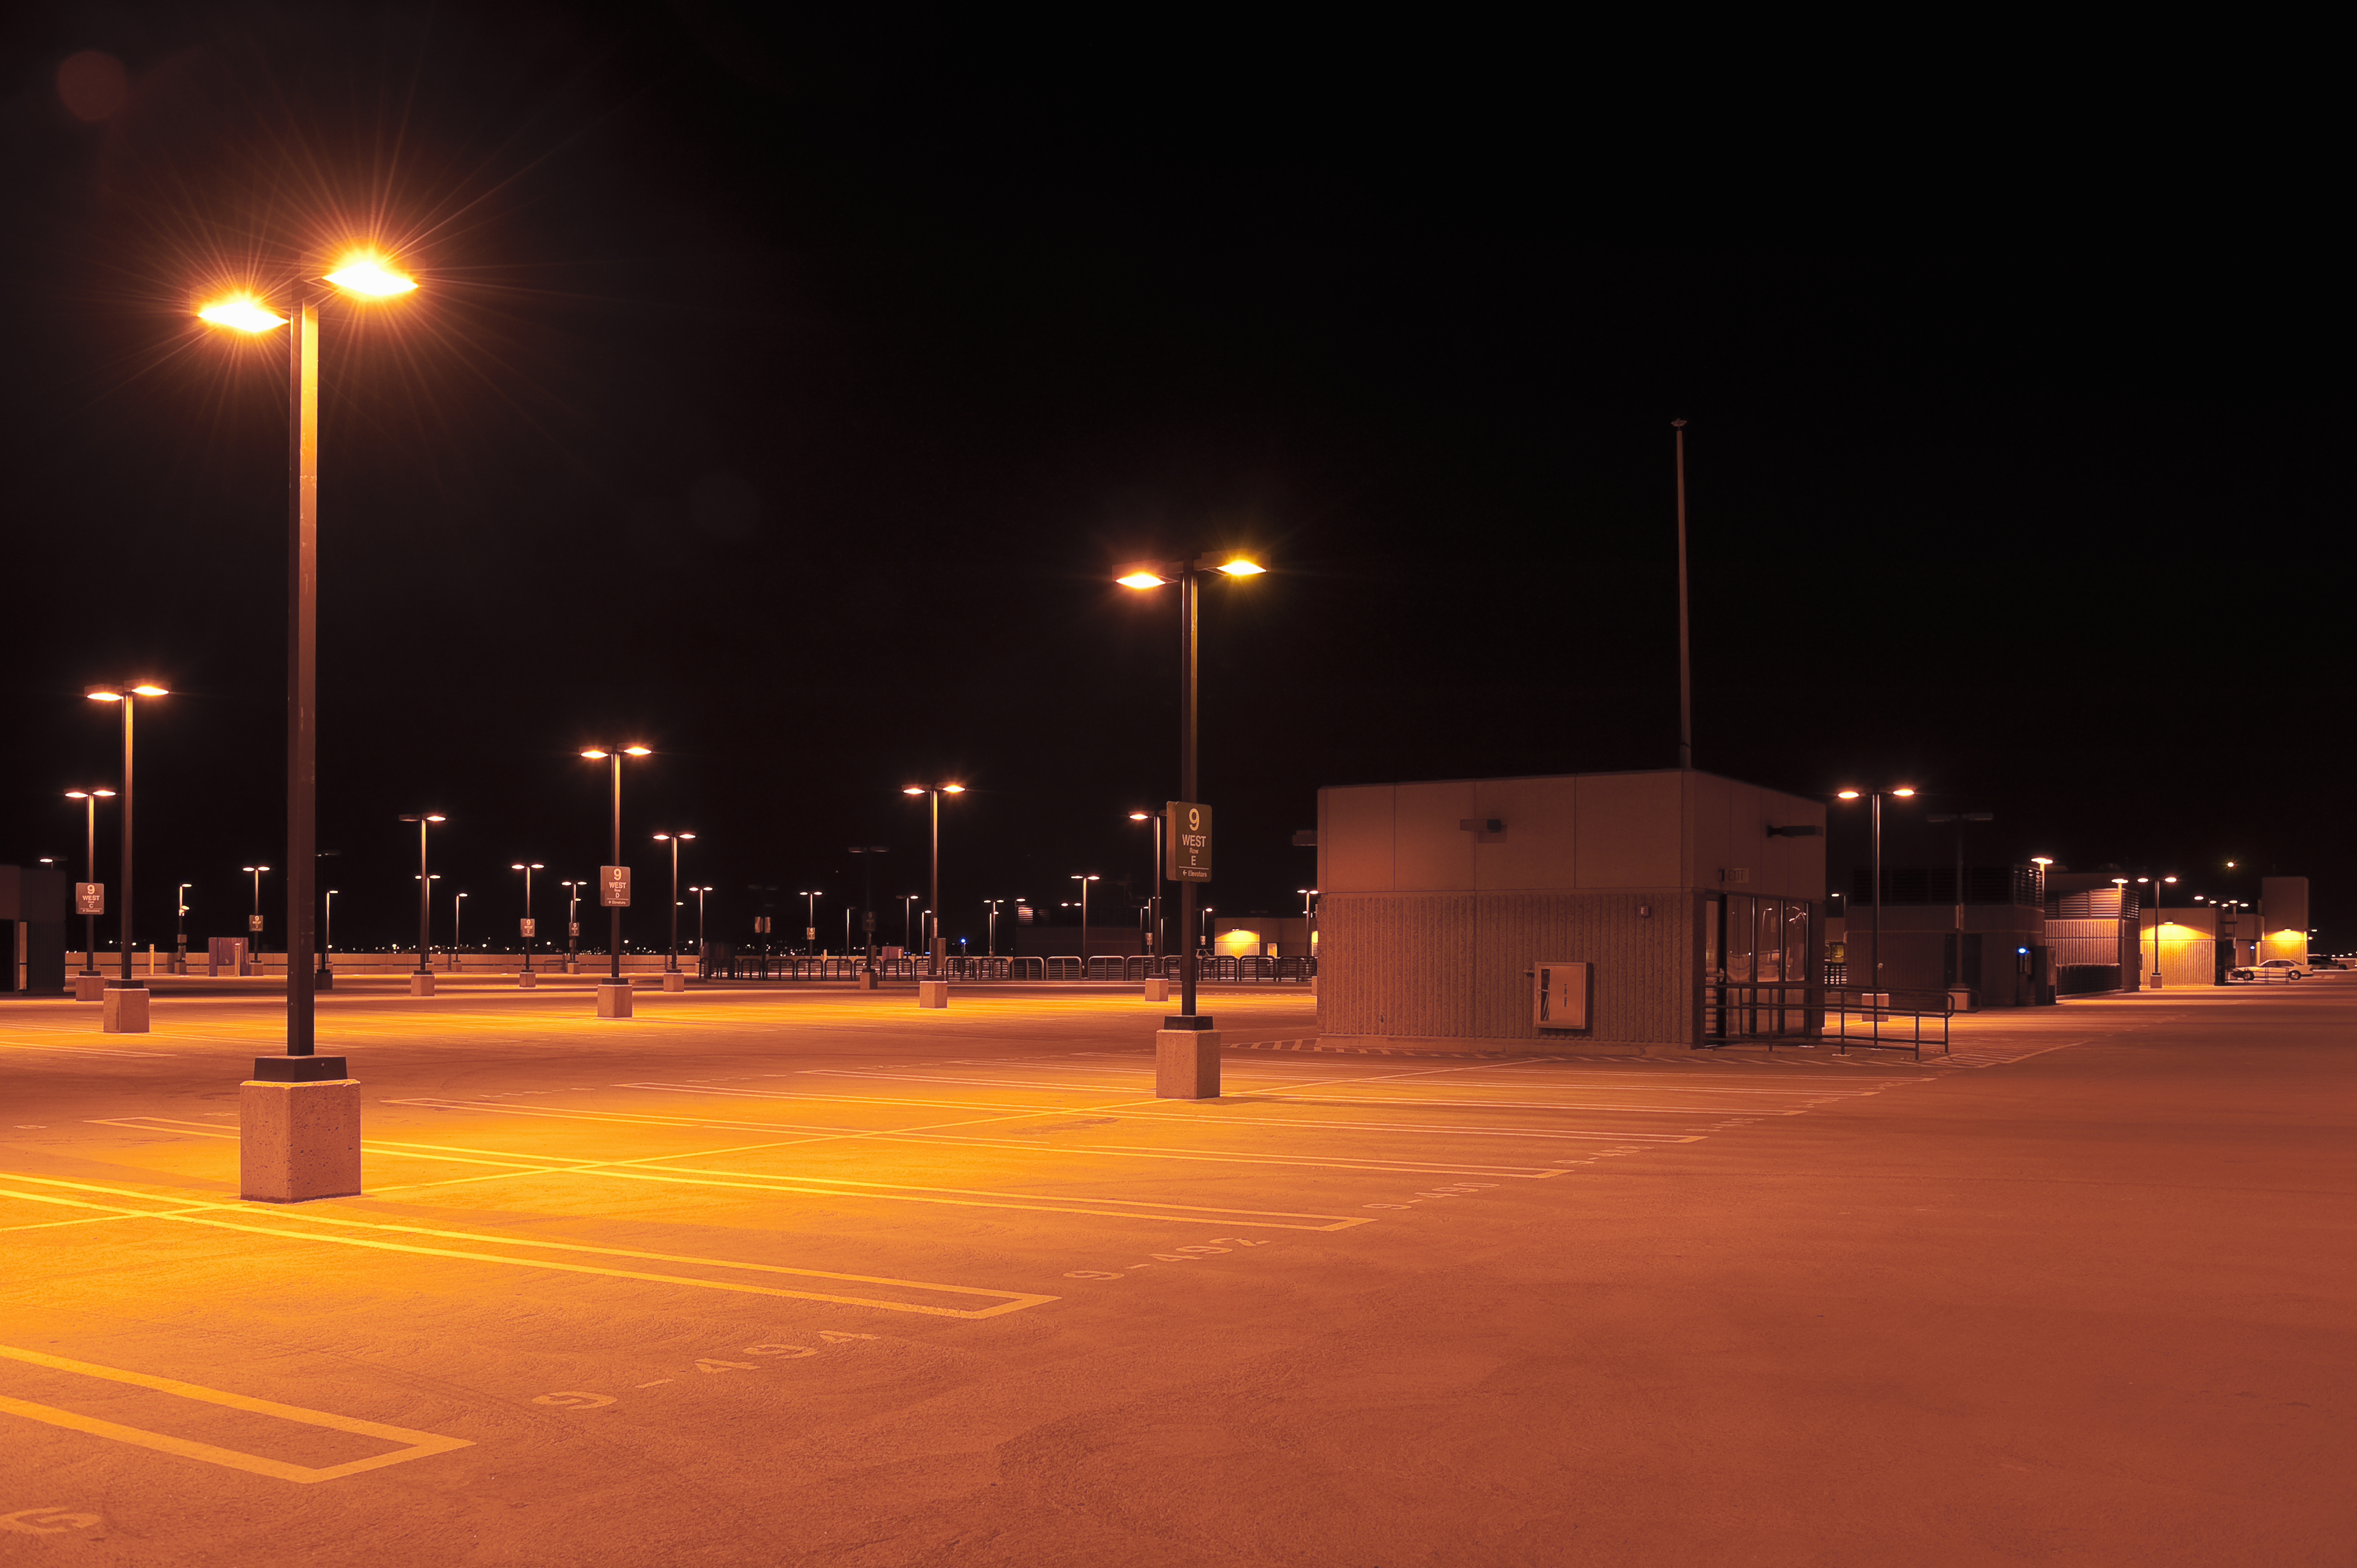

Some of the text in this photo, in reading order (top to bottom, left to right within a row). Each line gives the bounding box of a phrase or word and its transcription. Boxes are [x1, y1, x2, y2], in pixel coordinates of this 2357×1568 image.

[1189, 808, 1200, 831] 9
[1182, 834, 1207, 847] WEST
[1191, 856, 1196, 866] E
[614, 868, 621, 880] 9
[1728, 870, 1744, 881] EXIT
[87, 884, 95, 895] 9
